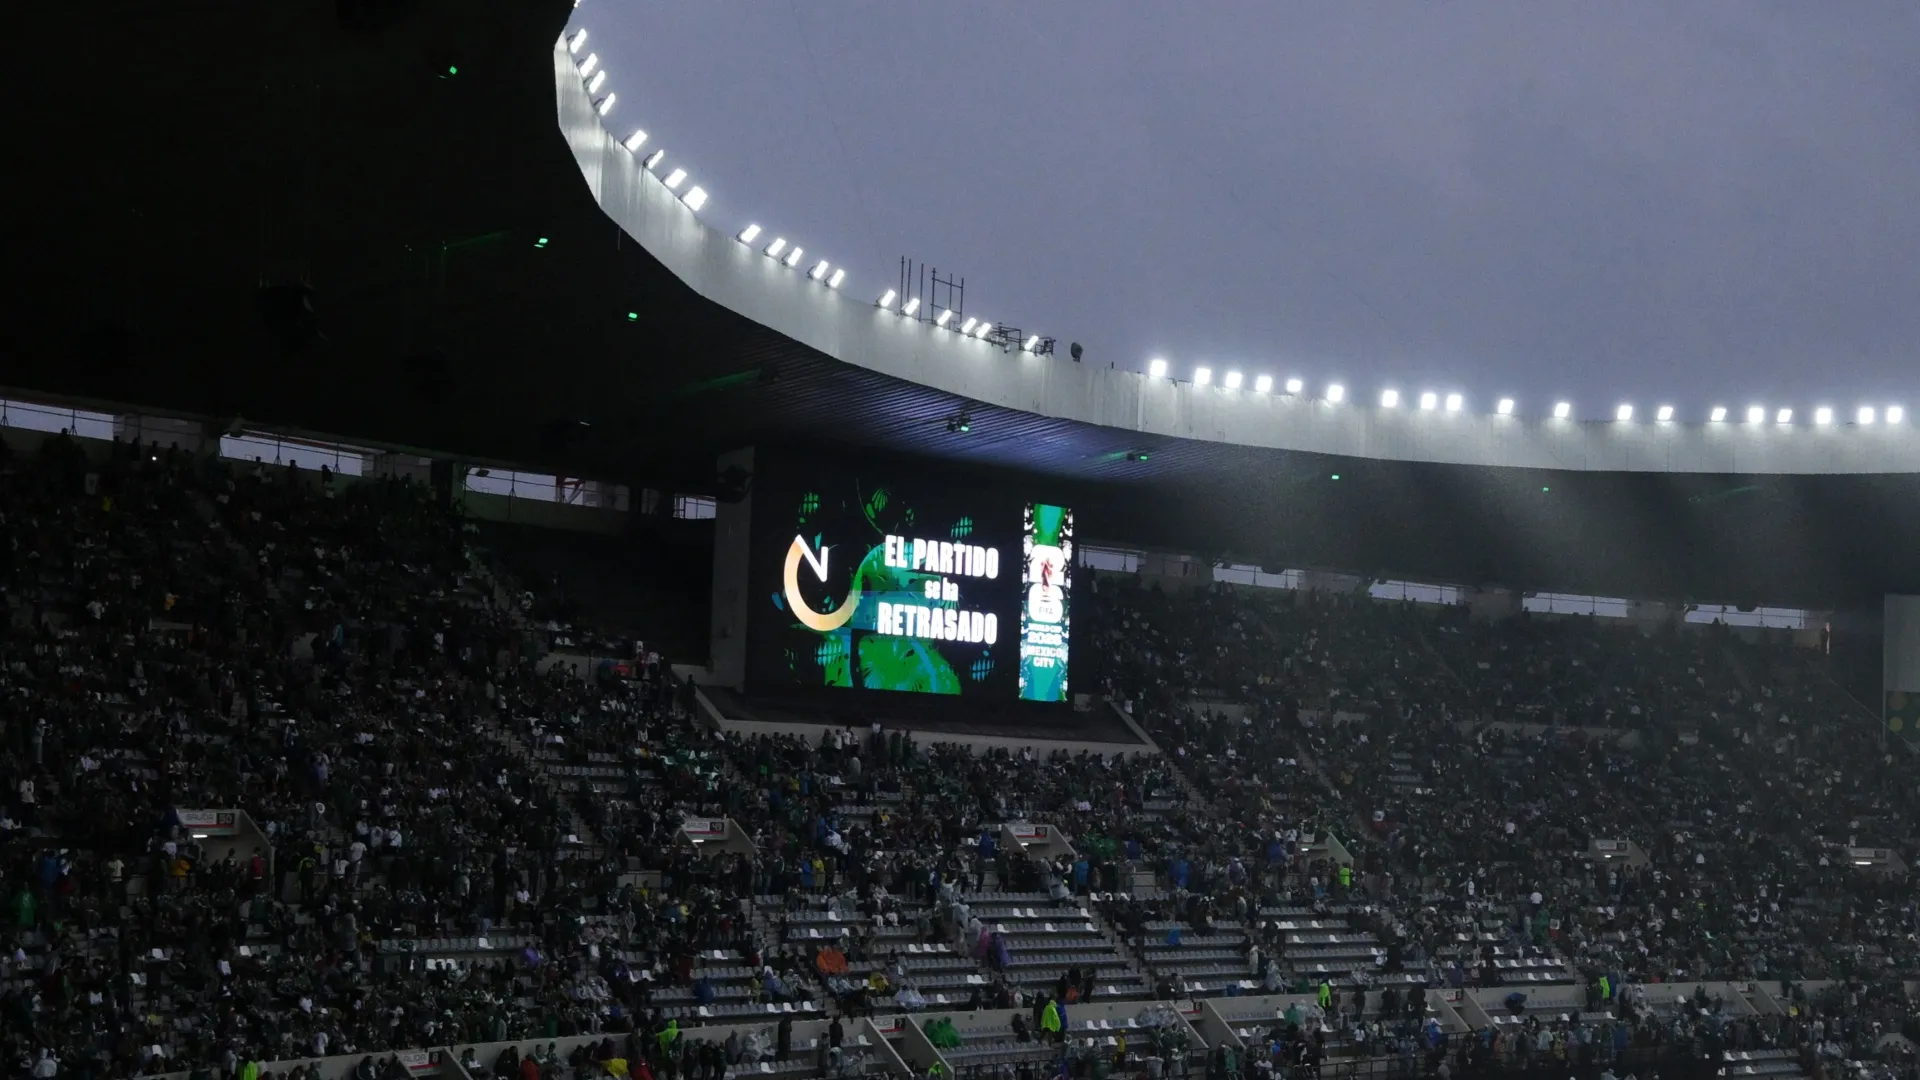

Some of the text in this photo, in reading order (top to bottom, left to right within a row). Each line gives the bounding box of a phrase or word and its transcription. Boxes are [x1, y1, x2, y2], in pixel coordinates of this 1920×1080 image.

[884, 534, 1000, 580] EL PARTIDO
[924, 577, 959, 602] se ha
[877, 602, 998, 645] RETRASADO
[1027, 645, 1063, 658] MEXICO
[1033, 656, 1055, 668] CITY
